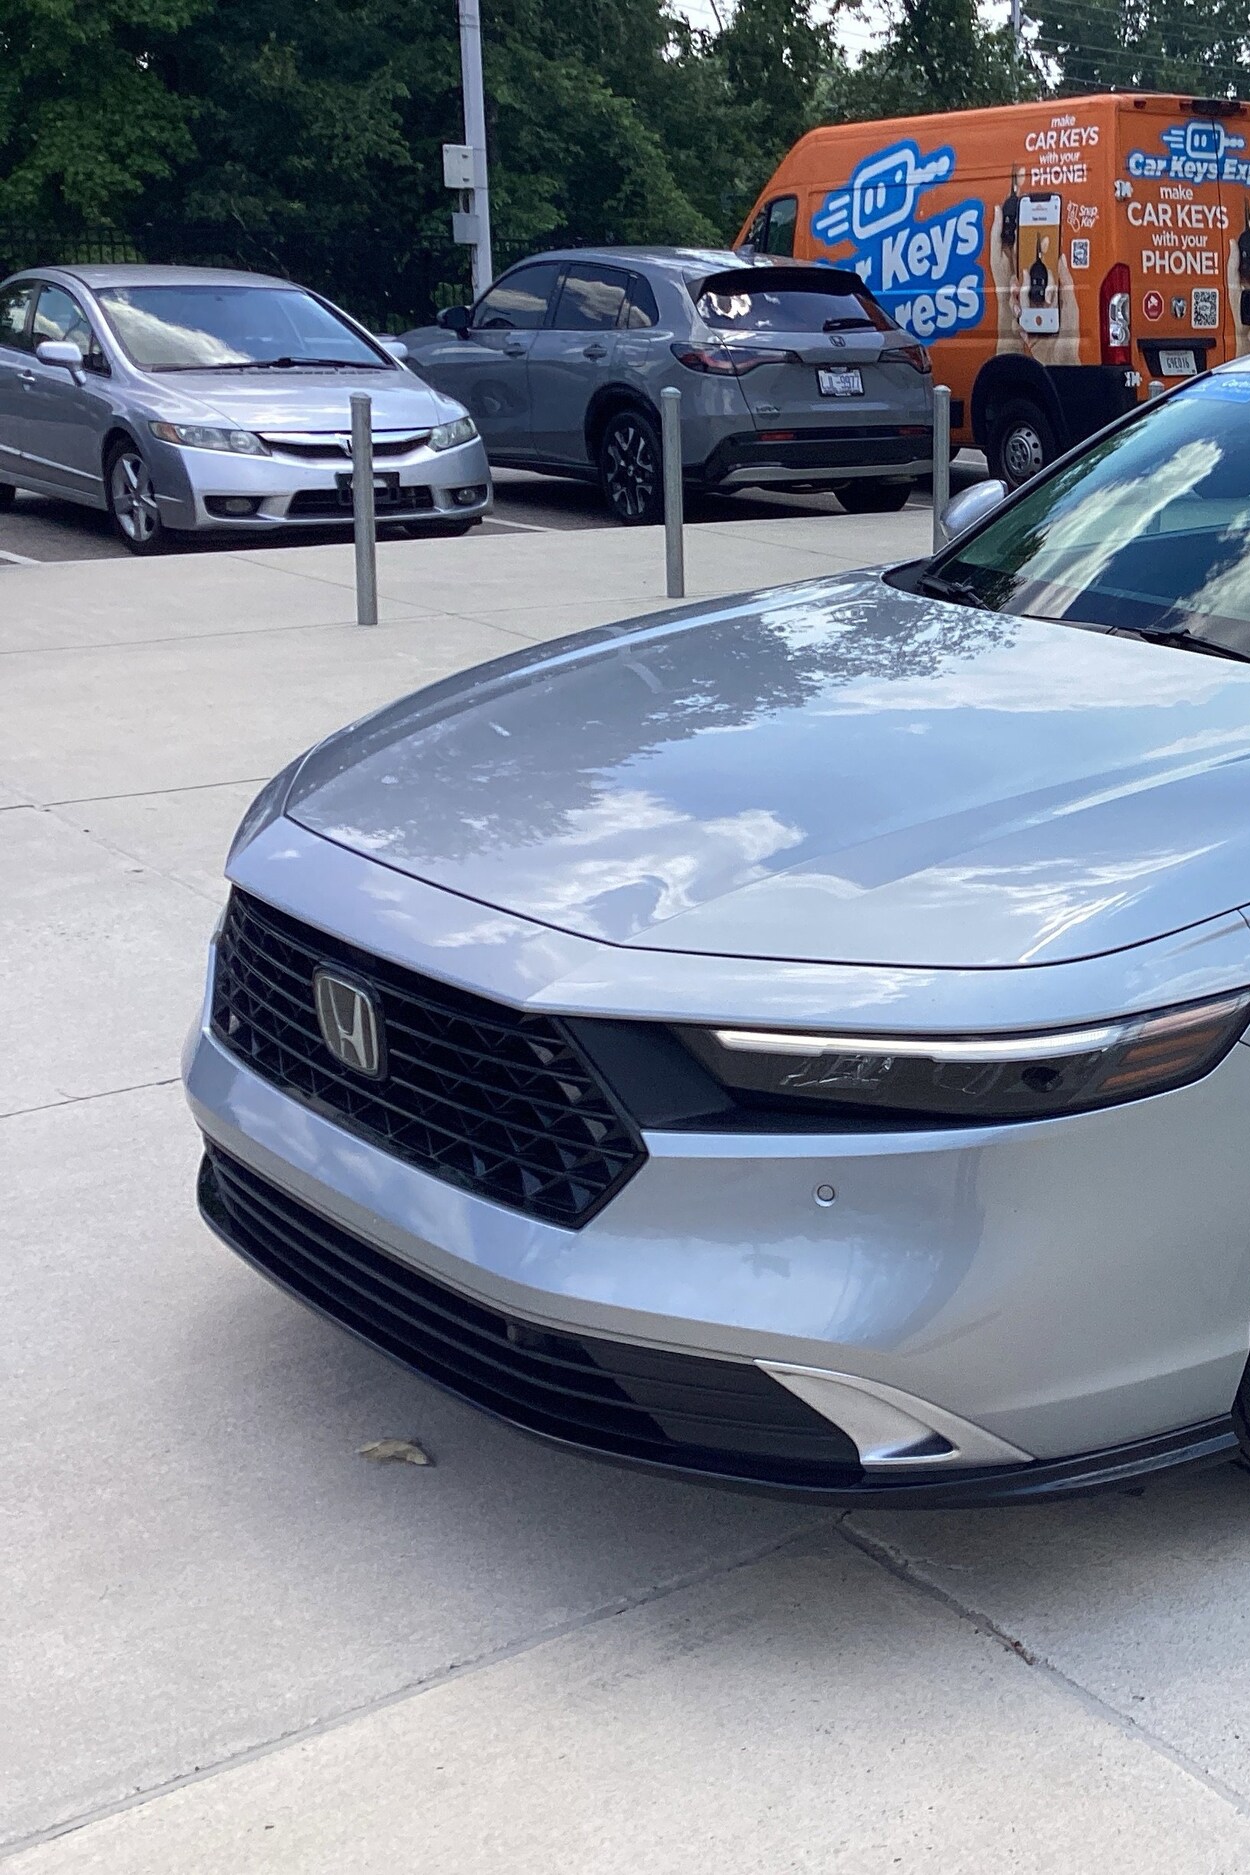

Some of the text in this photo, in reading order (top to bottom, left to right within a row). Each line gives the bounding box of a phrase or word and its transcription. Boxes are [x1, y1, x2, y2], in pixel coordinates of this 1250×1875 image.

[1051, 115, 1076, 128] make
[1025, 126, 1099, 151] CAR KEYS
[1040, 152, 1080, 165] with your
[1129, 153, 1166, 176] Car
[1169, 156, 1218, 183] Keys
[1031, 164, 1087, 186] PHONE!
[1160, 184, 1193, 200] make
[1127, 202, 1229, 229] CAR KEYS
[882, 209, 979, 292] Keys
[1152, 231, 1208, 249] with your
[1141, 251, 1219, 275] PHONE!
[895, 274, 980, 337] ress
